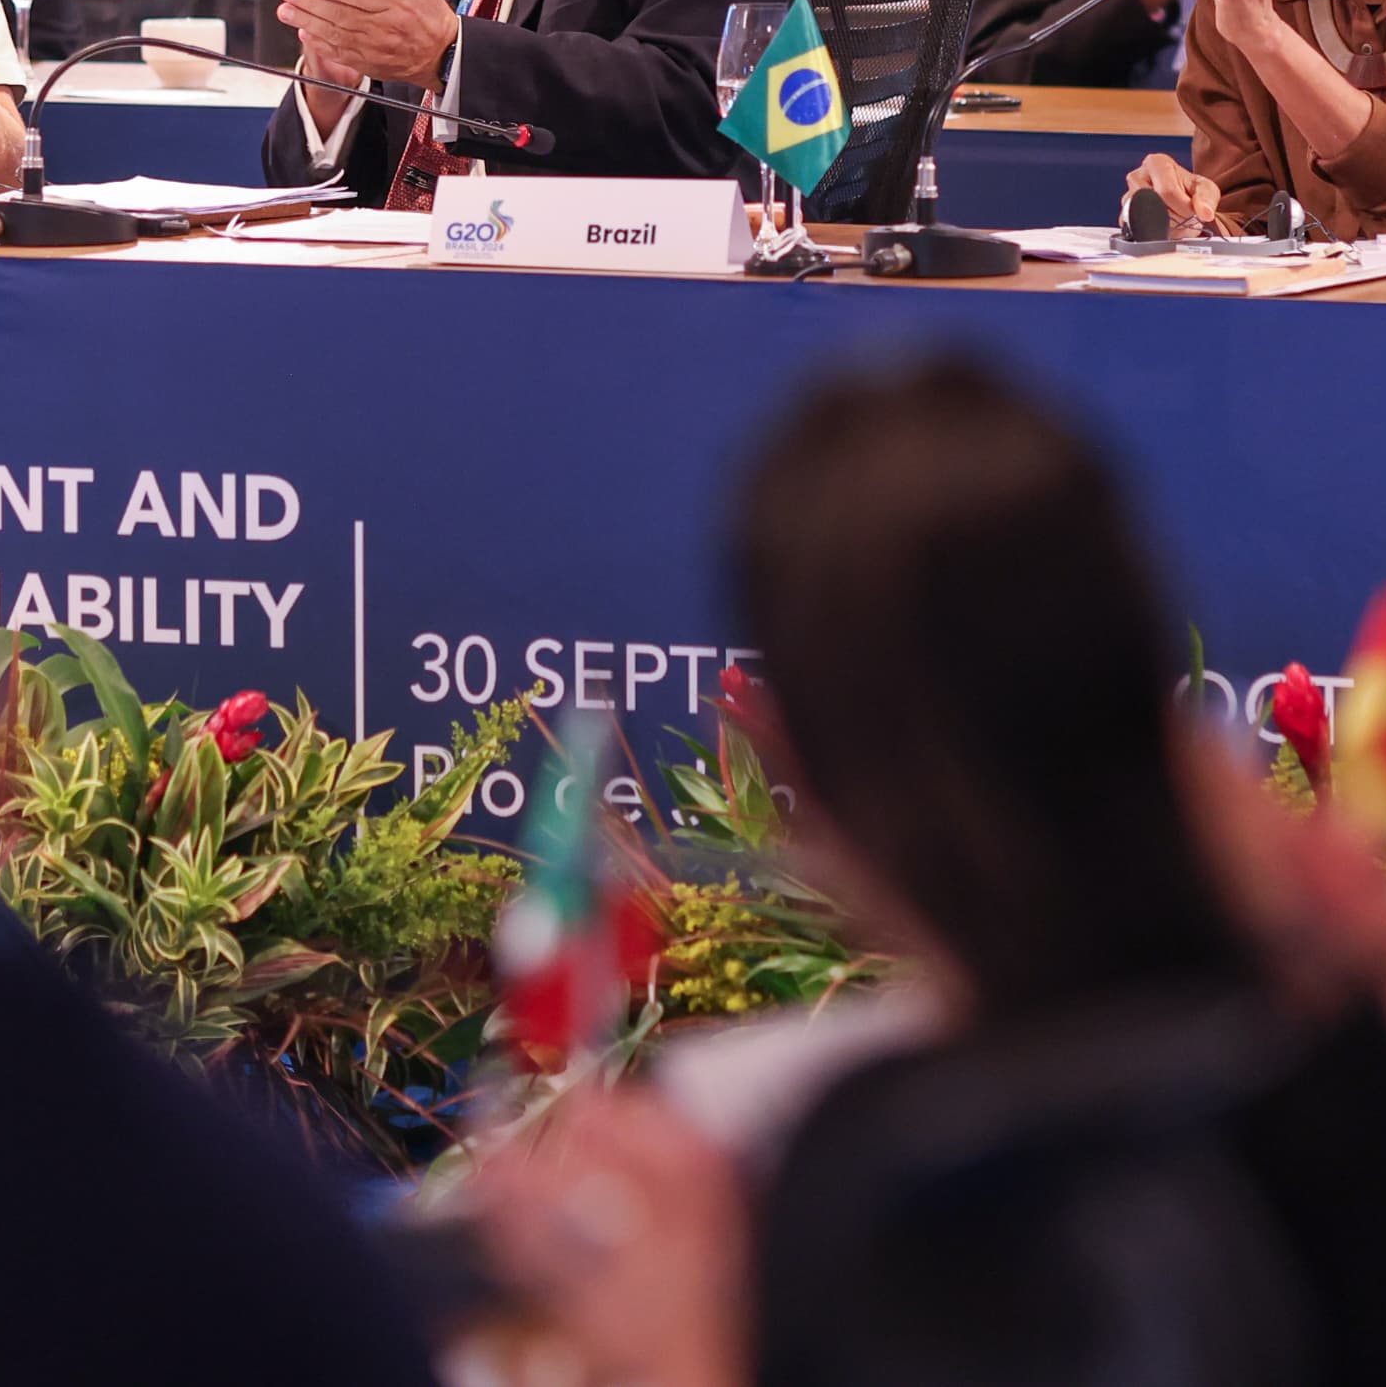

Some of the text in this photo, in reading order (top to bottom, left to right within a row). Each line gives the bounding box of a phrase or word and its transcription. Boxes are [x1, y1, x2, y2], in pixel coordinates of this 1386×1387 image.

[446, 222, 495, 242] G20
[586, 222, 656, 244] Brazil
[116, 470, 301, 542] AND
[410, 632, 498, 705] 30
[413, 744, 525, 818] Ro
